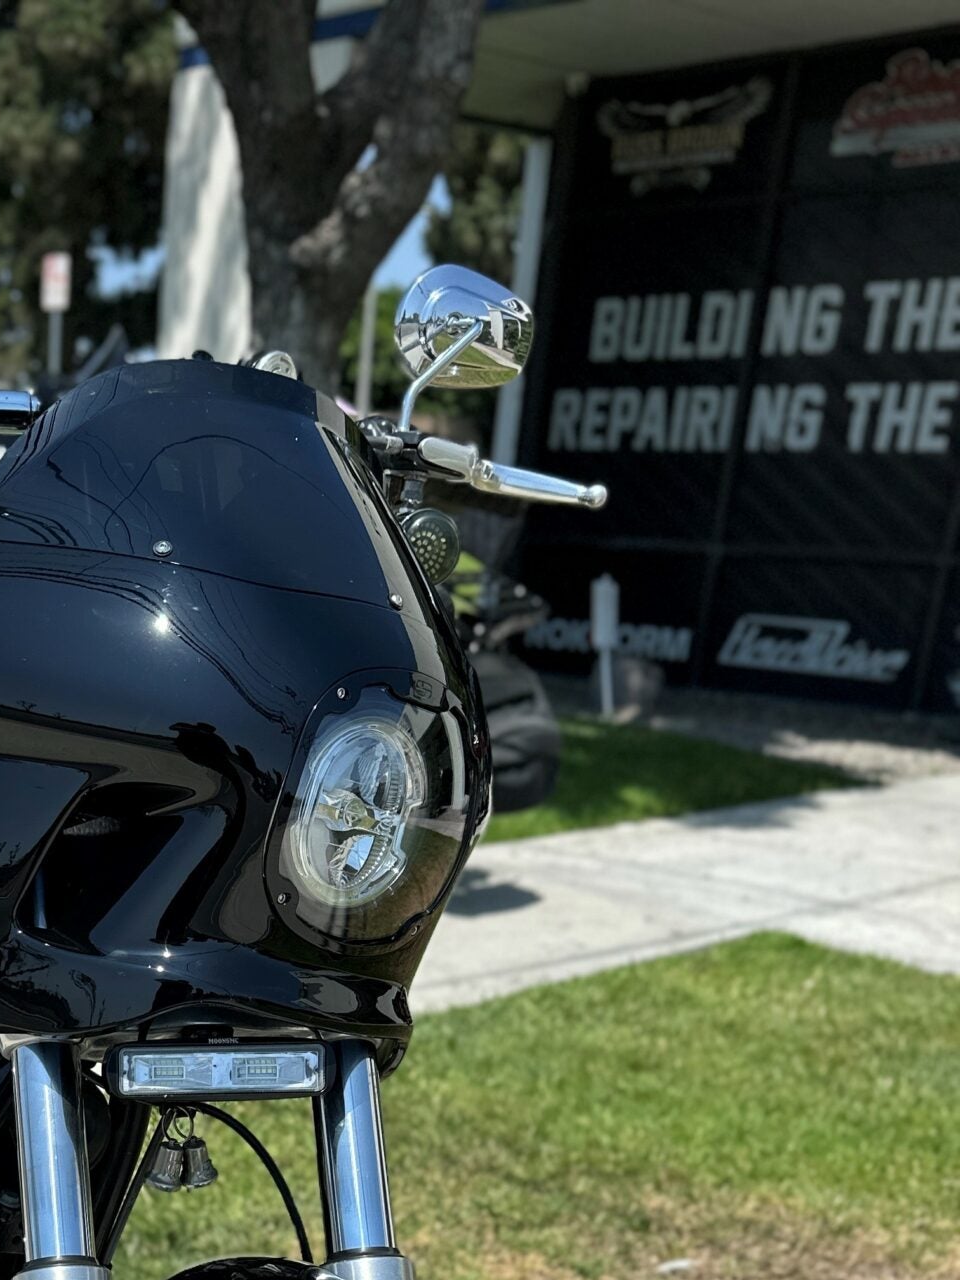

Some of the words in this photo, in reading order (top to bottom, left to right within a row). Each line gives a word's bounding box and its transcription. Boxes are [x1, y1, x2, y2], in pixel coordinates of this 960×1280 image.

[588, 284, 844, 363] BUILDING
[547, 383, 827, 453] REPAIRING
[844, 381, 959, 454] THE
